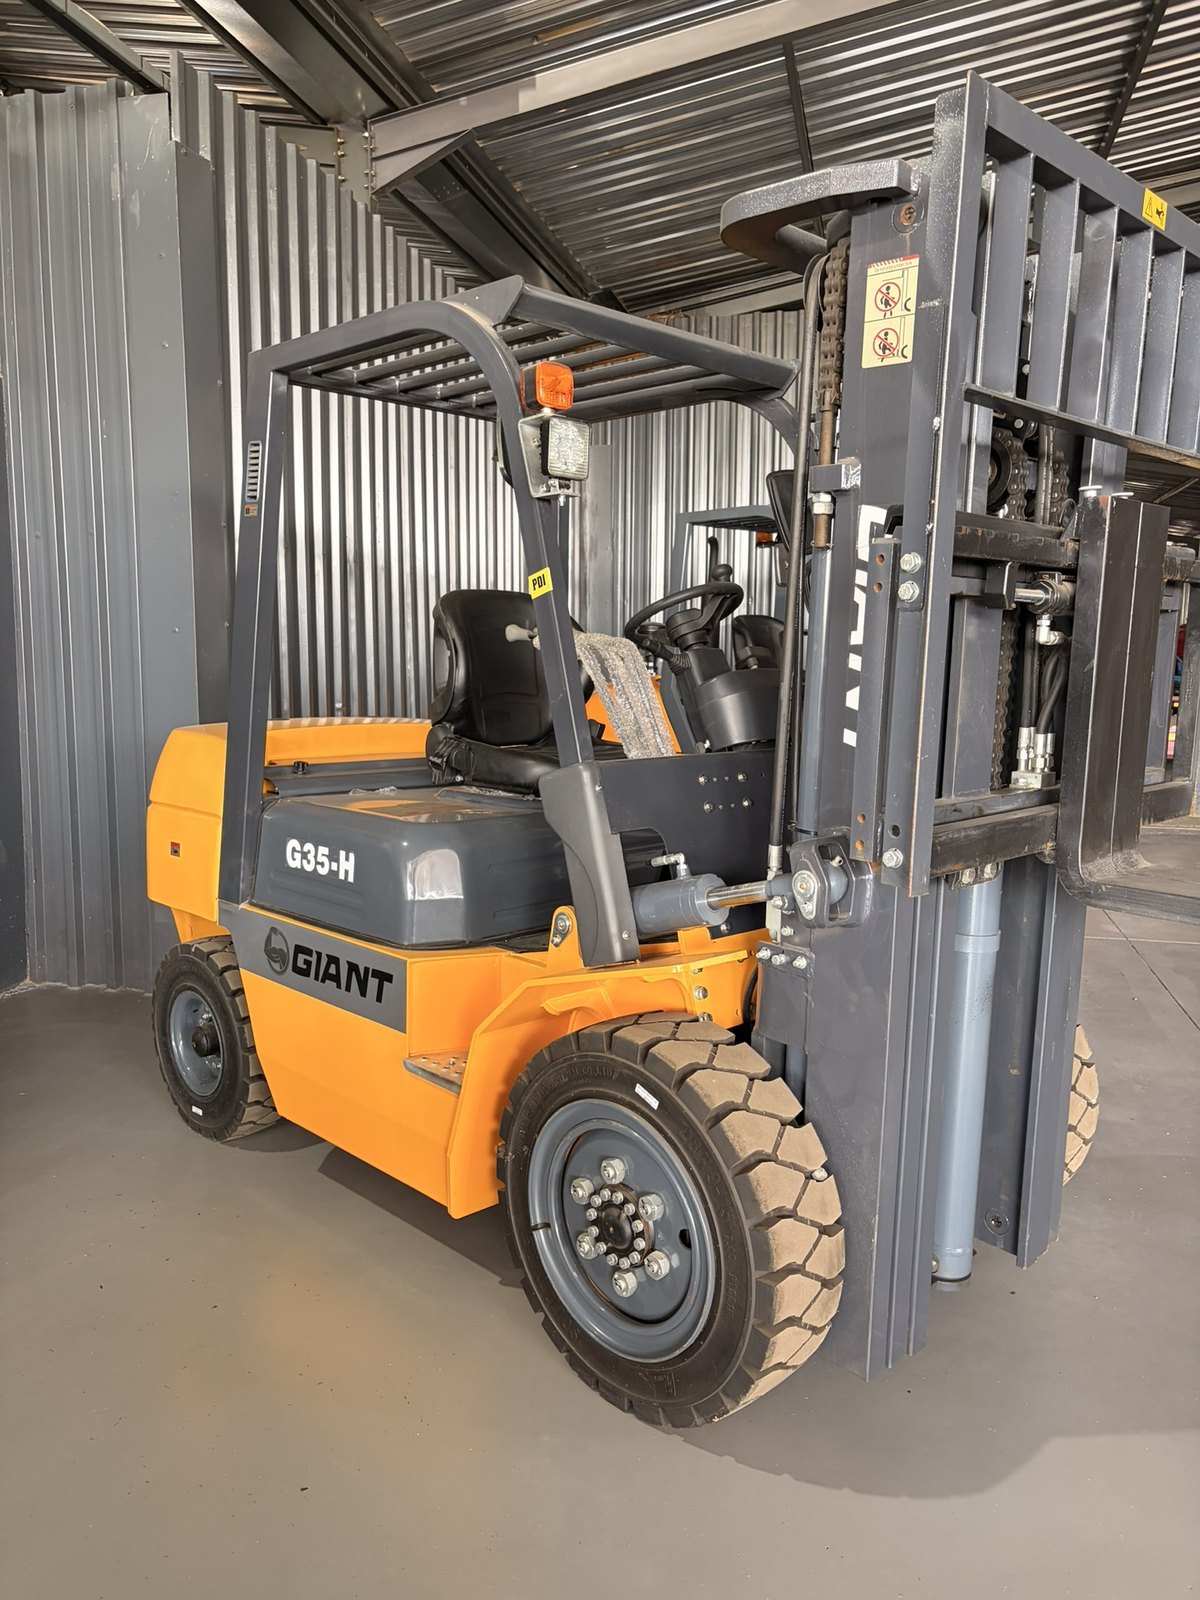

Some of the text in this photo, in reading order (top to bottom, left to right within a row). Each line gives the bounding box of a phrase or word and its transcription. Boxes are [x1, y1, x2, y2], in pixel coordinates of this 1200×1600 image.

[532, 574, 546, 591] PDI
[286, 838, 355, 883] G35-H
[291, 943, 394, 1004] GIANT
